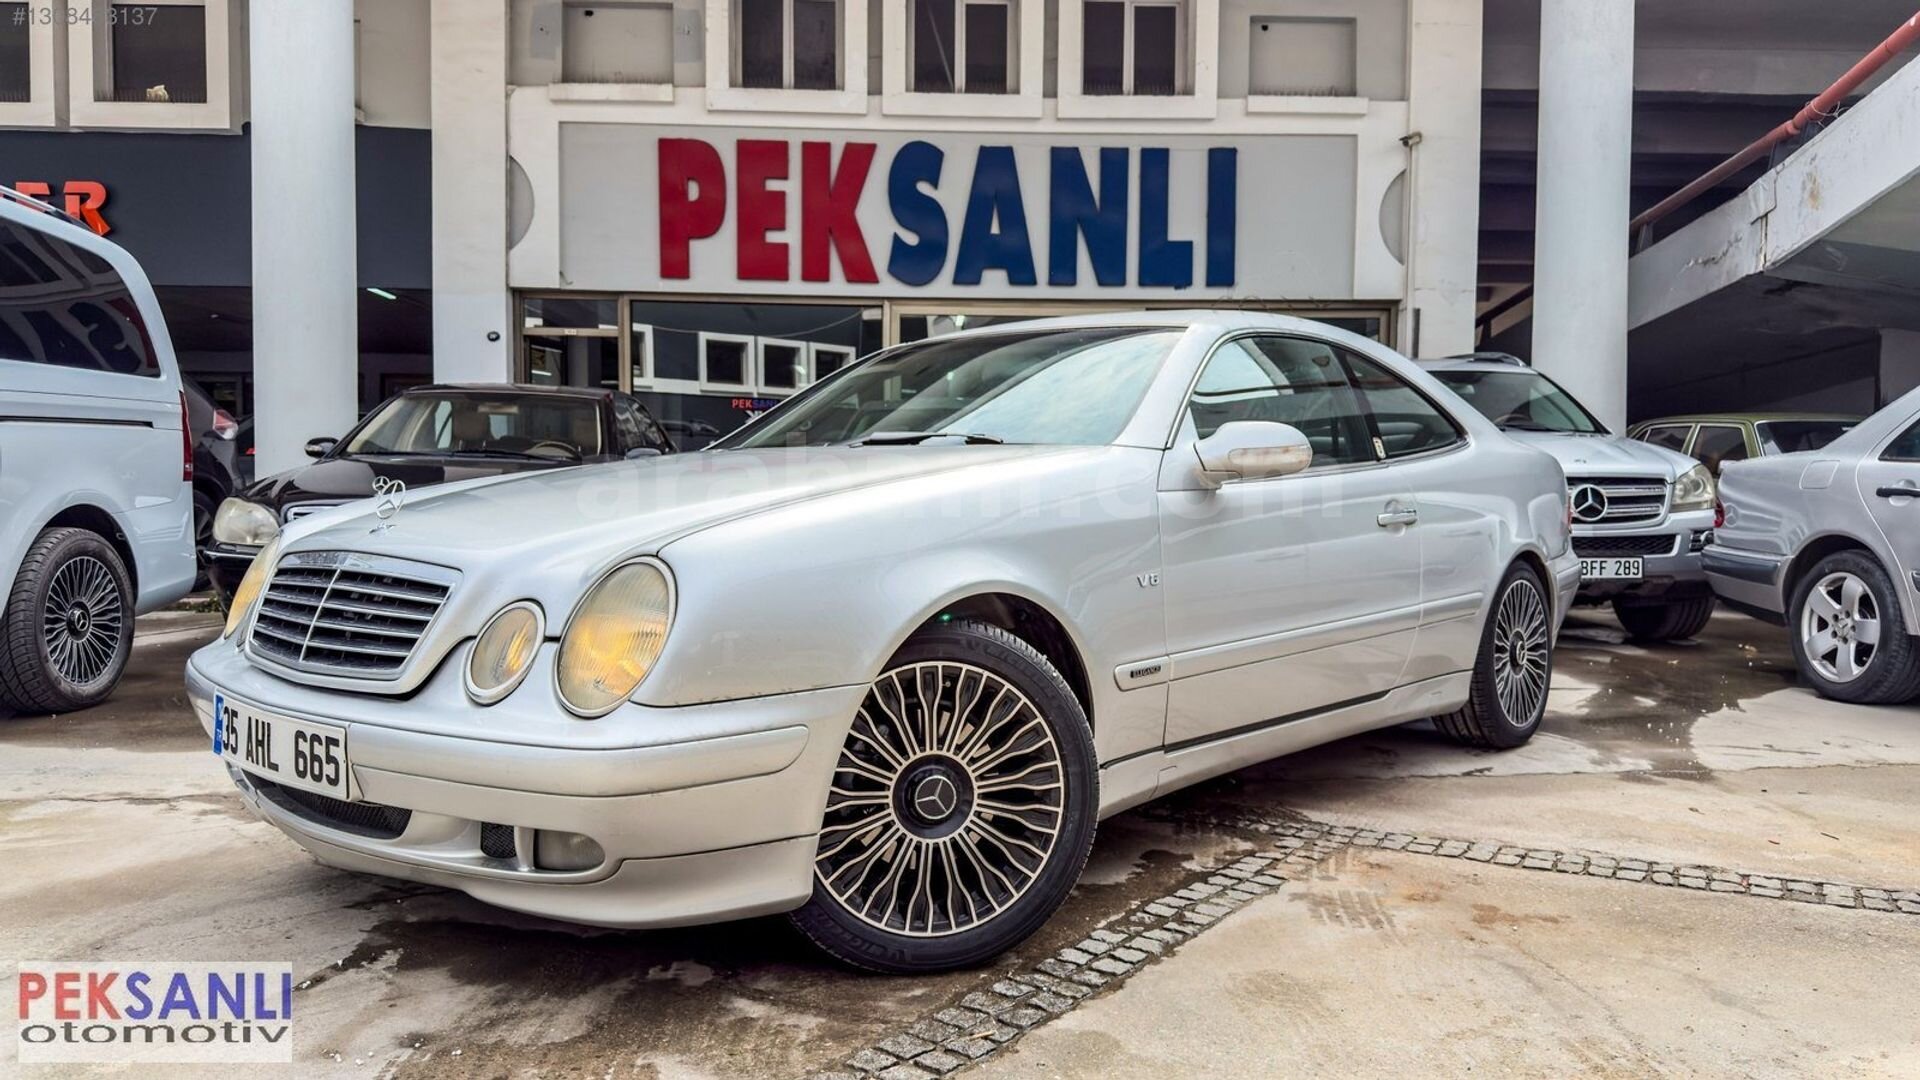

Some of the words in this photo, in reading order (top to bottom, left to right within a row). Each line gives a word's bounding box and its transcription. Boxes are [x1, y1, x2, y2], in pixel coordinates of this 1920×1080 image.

[0, 181, 111, 236] ER
[658, 138, 1237, 288] PEKSANLI
[1614, 560, 1640, 576] 289
[222, 706, 239, 755] 35
[246, 716, 279, 772] AHL
[294, 729, 340, 787] 665
